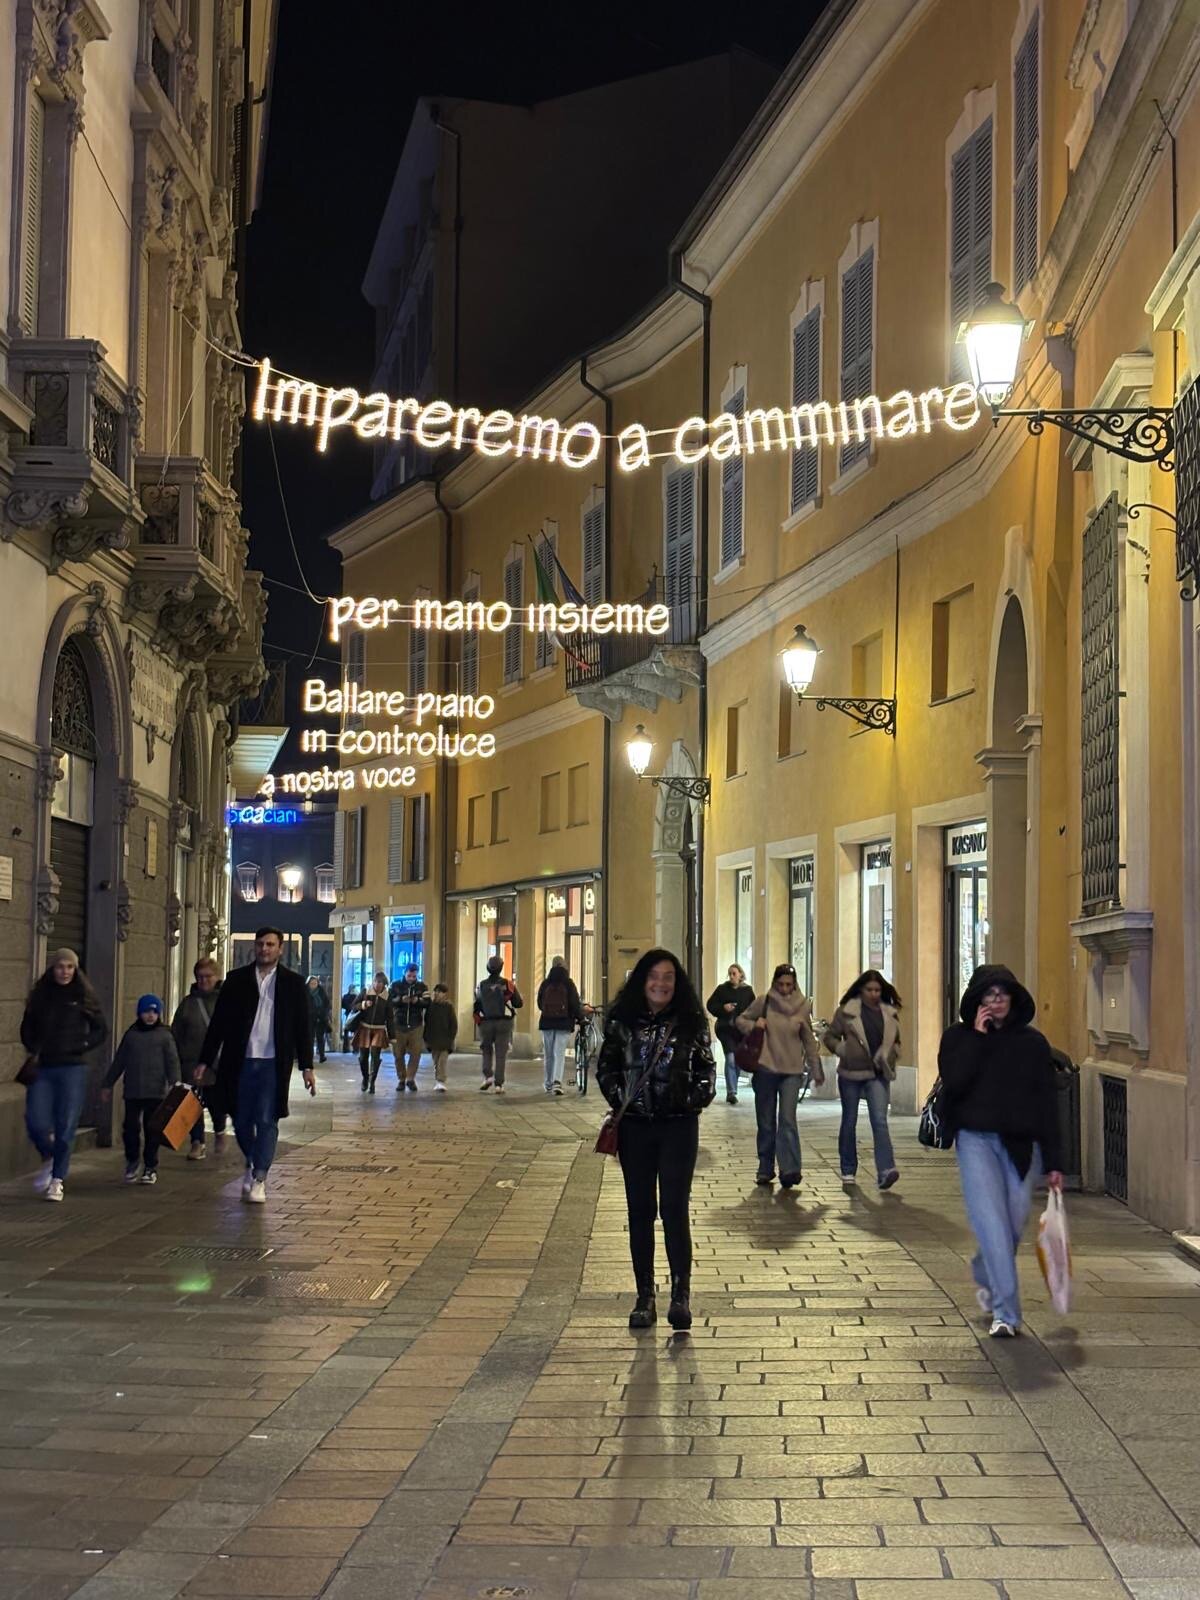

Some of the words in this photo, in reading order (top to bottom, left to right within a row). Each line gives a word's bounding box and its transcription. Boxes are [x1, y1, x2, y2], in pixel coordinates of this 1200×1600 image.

[252, 357, 601, 468] Impareremo
[617, 422, 651, 472] a
[674, 382, 981, 465] camminare
[327, 596, 399, 642] per
[414, 598, 512, 632] mano
[528, 601, 670, 635] insieme
[303, 678, 406, 716] Ballare
[416, 692, 495, 727] piano
[302, 728, 327, 753] in
[338, 724, 496, 758] controluce
[257, 773, 276, 796] a
[281, 765, 355, 794] nostra
[361, 765, 416, 789] voce
